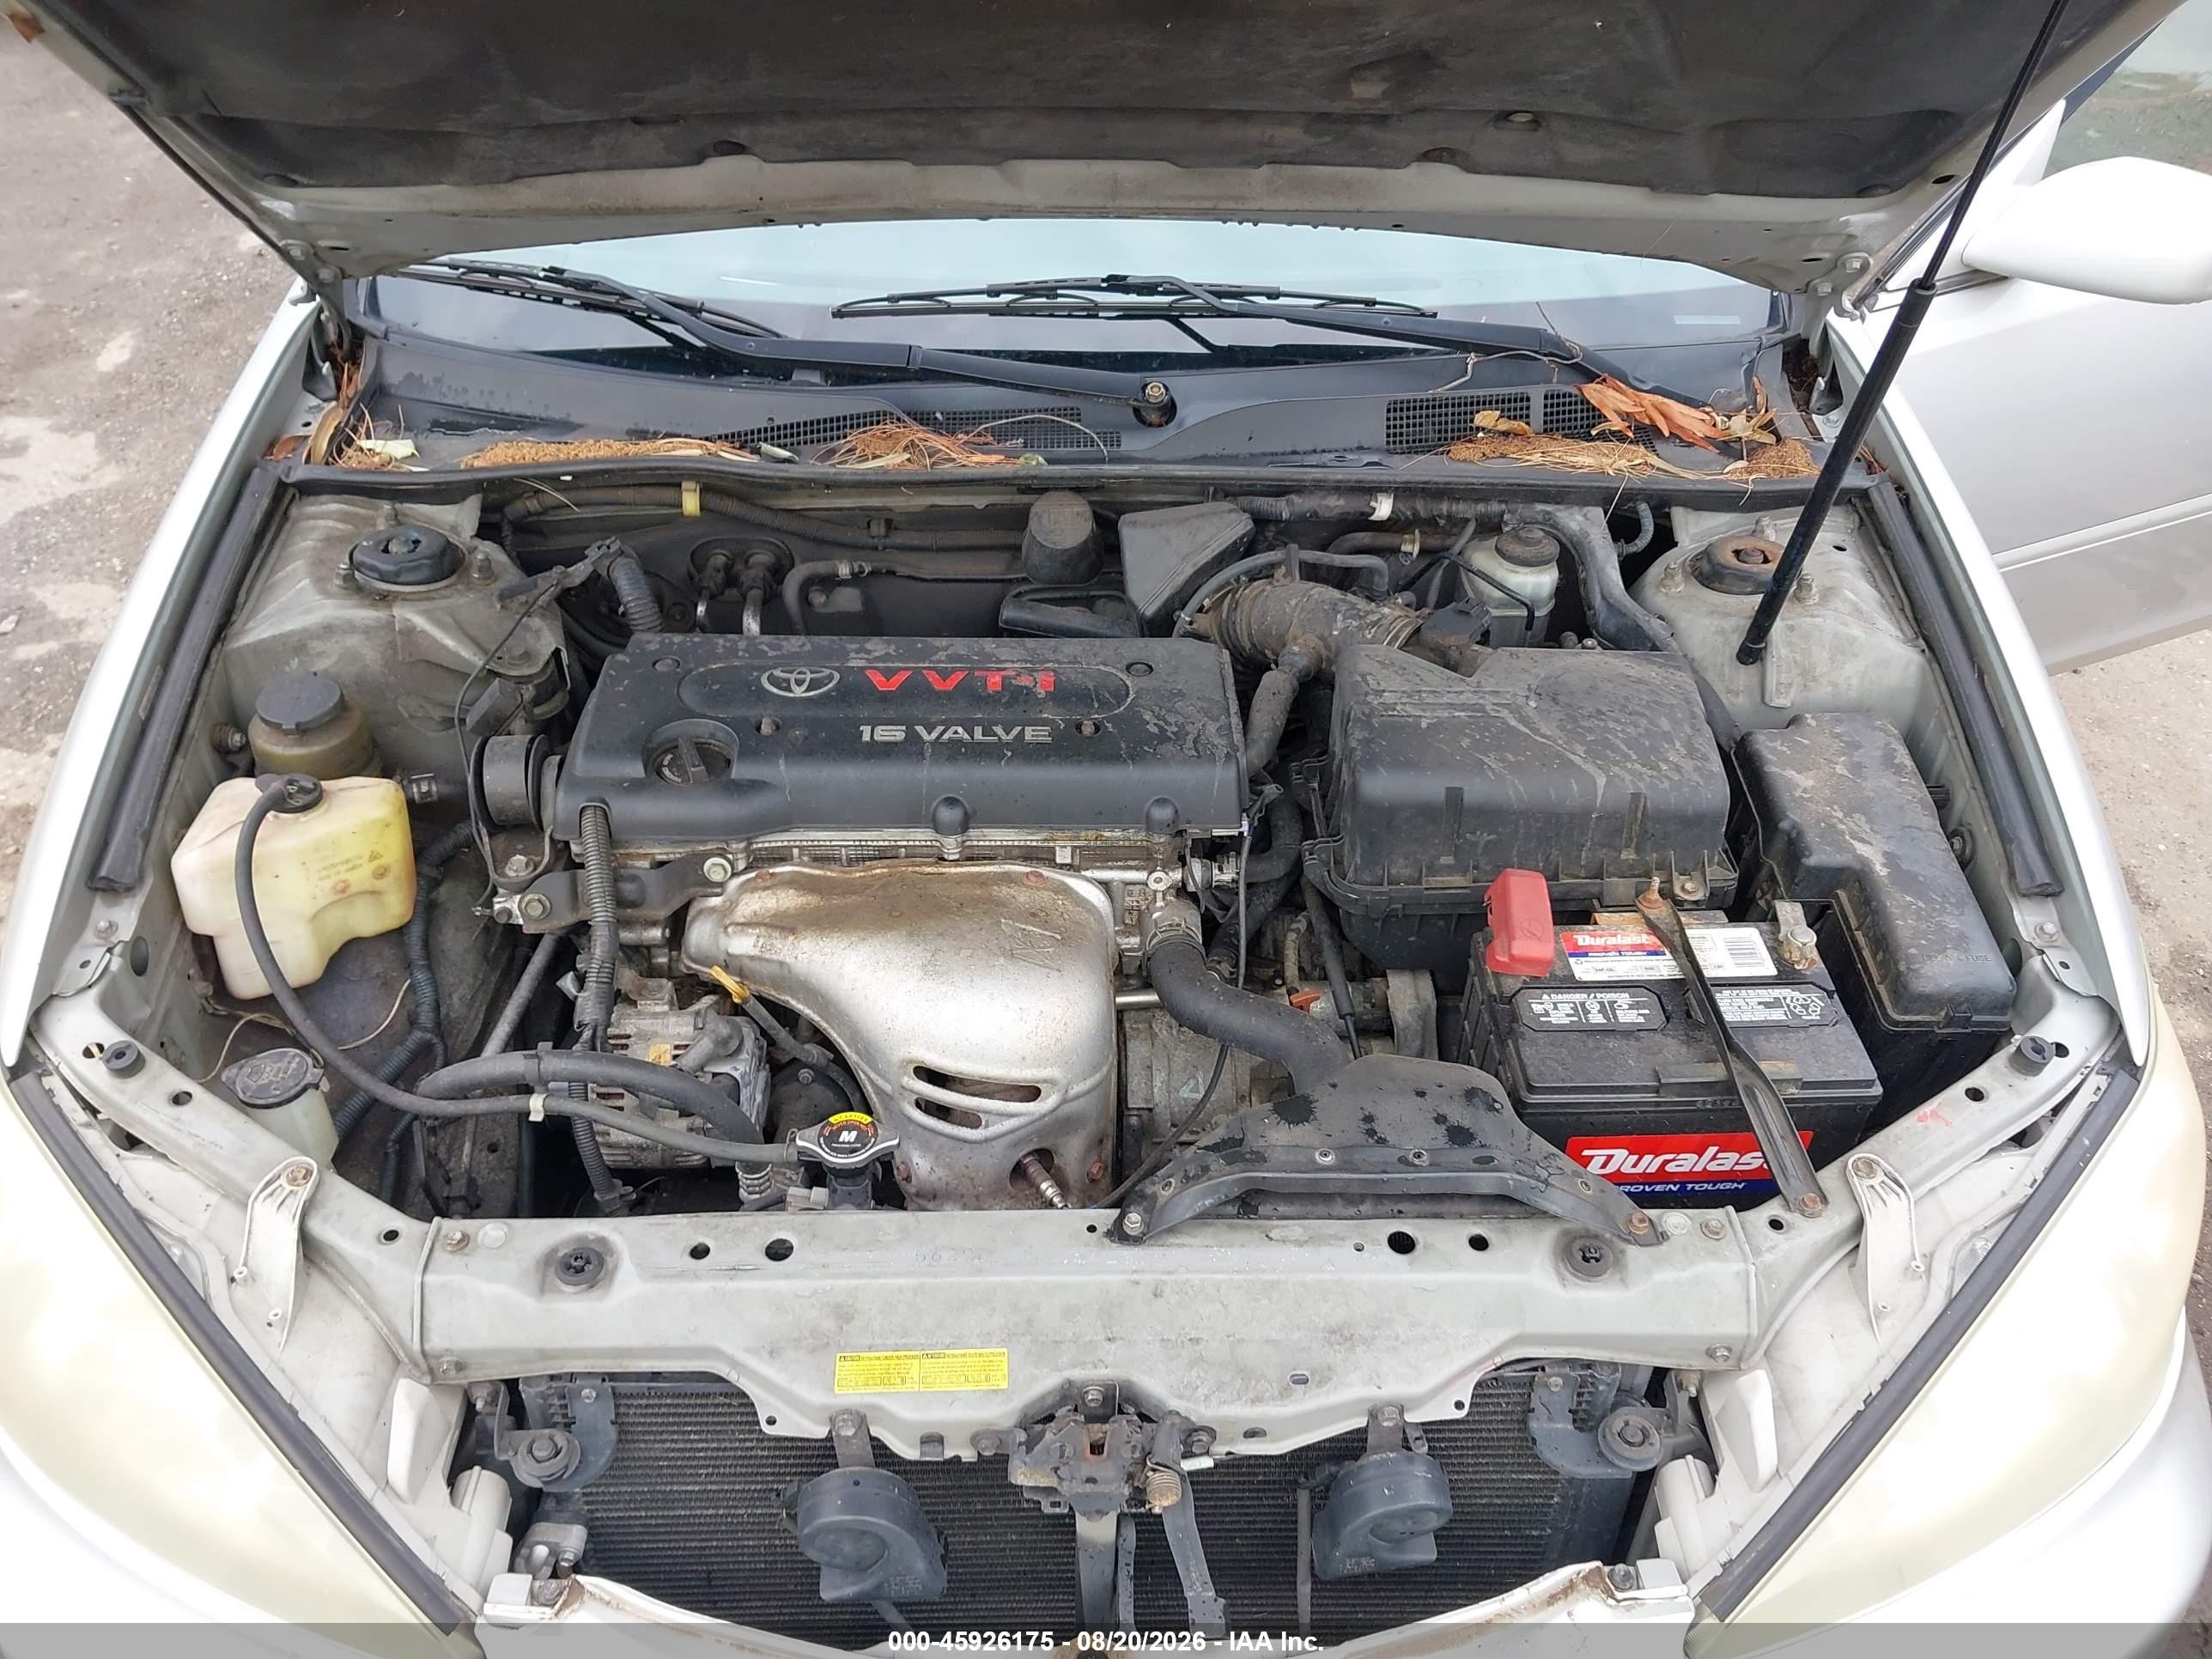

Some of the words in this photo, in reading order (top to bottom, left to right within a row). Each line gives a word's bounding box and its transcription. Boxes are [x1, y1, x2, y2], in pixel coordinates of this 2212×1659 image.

[860, 725, 908, 743] 16
[914, 725, 1053, 743] VALVE
[1572, 934, 1650, 947] Duralast
[838, 1130, 858, 1142] M
[1581, 1146, 1770, 1175] Duralas
[1616, 1184, 1680, 1193] ROVEN
[1686, 1182, 1744, 1191] TOUGH
